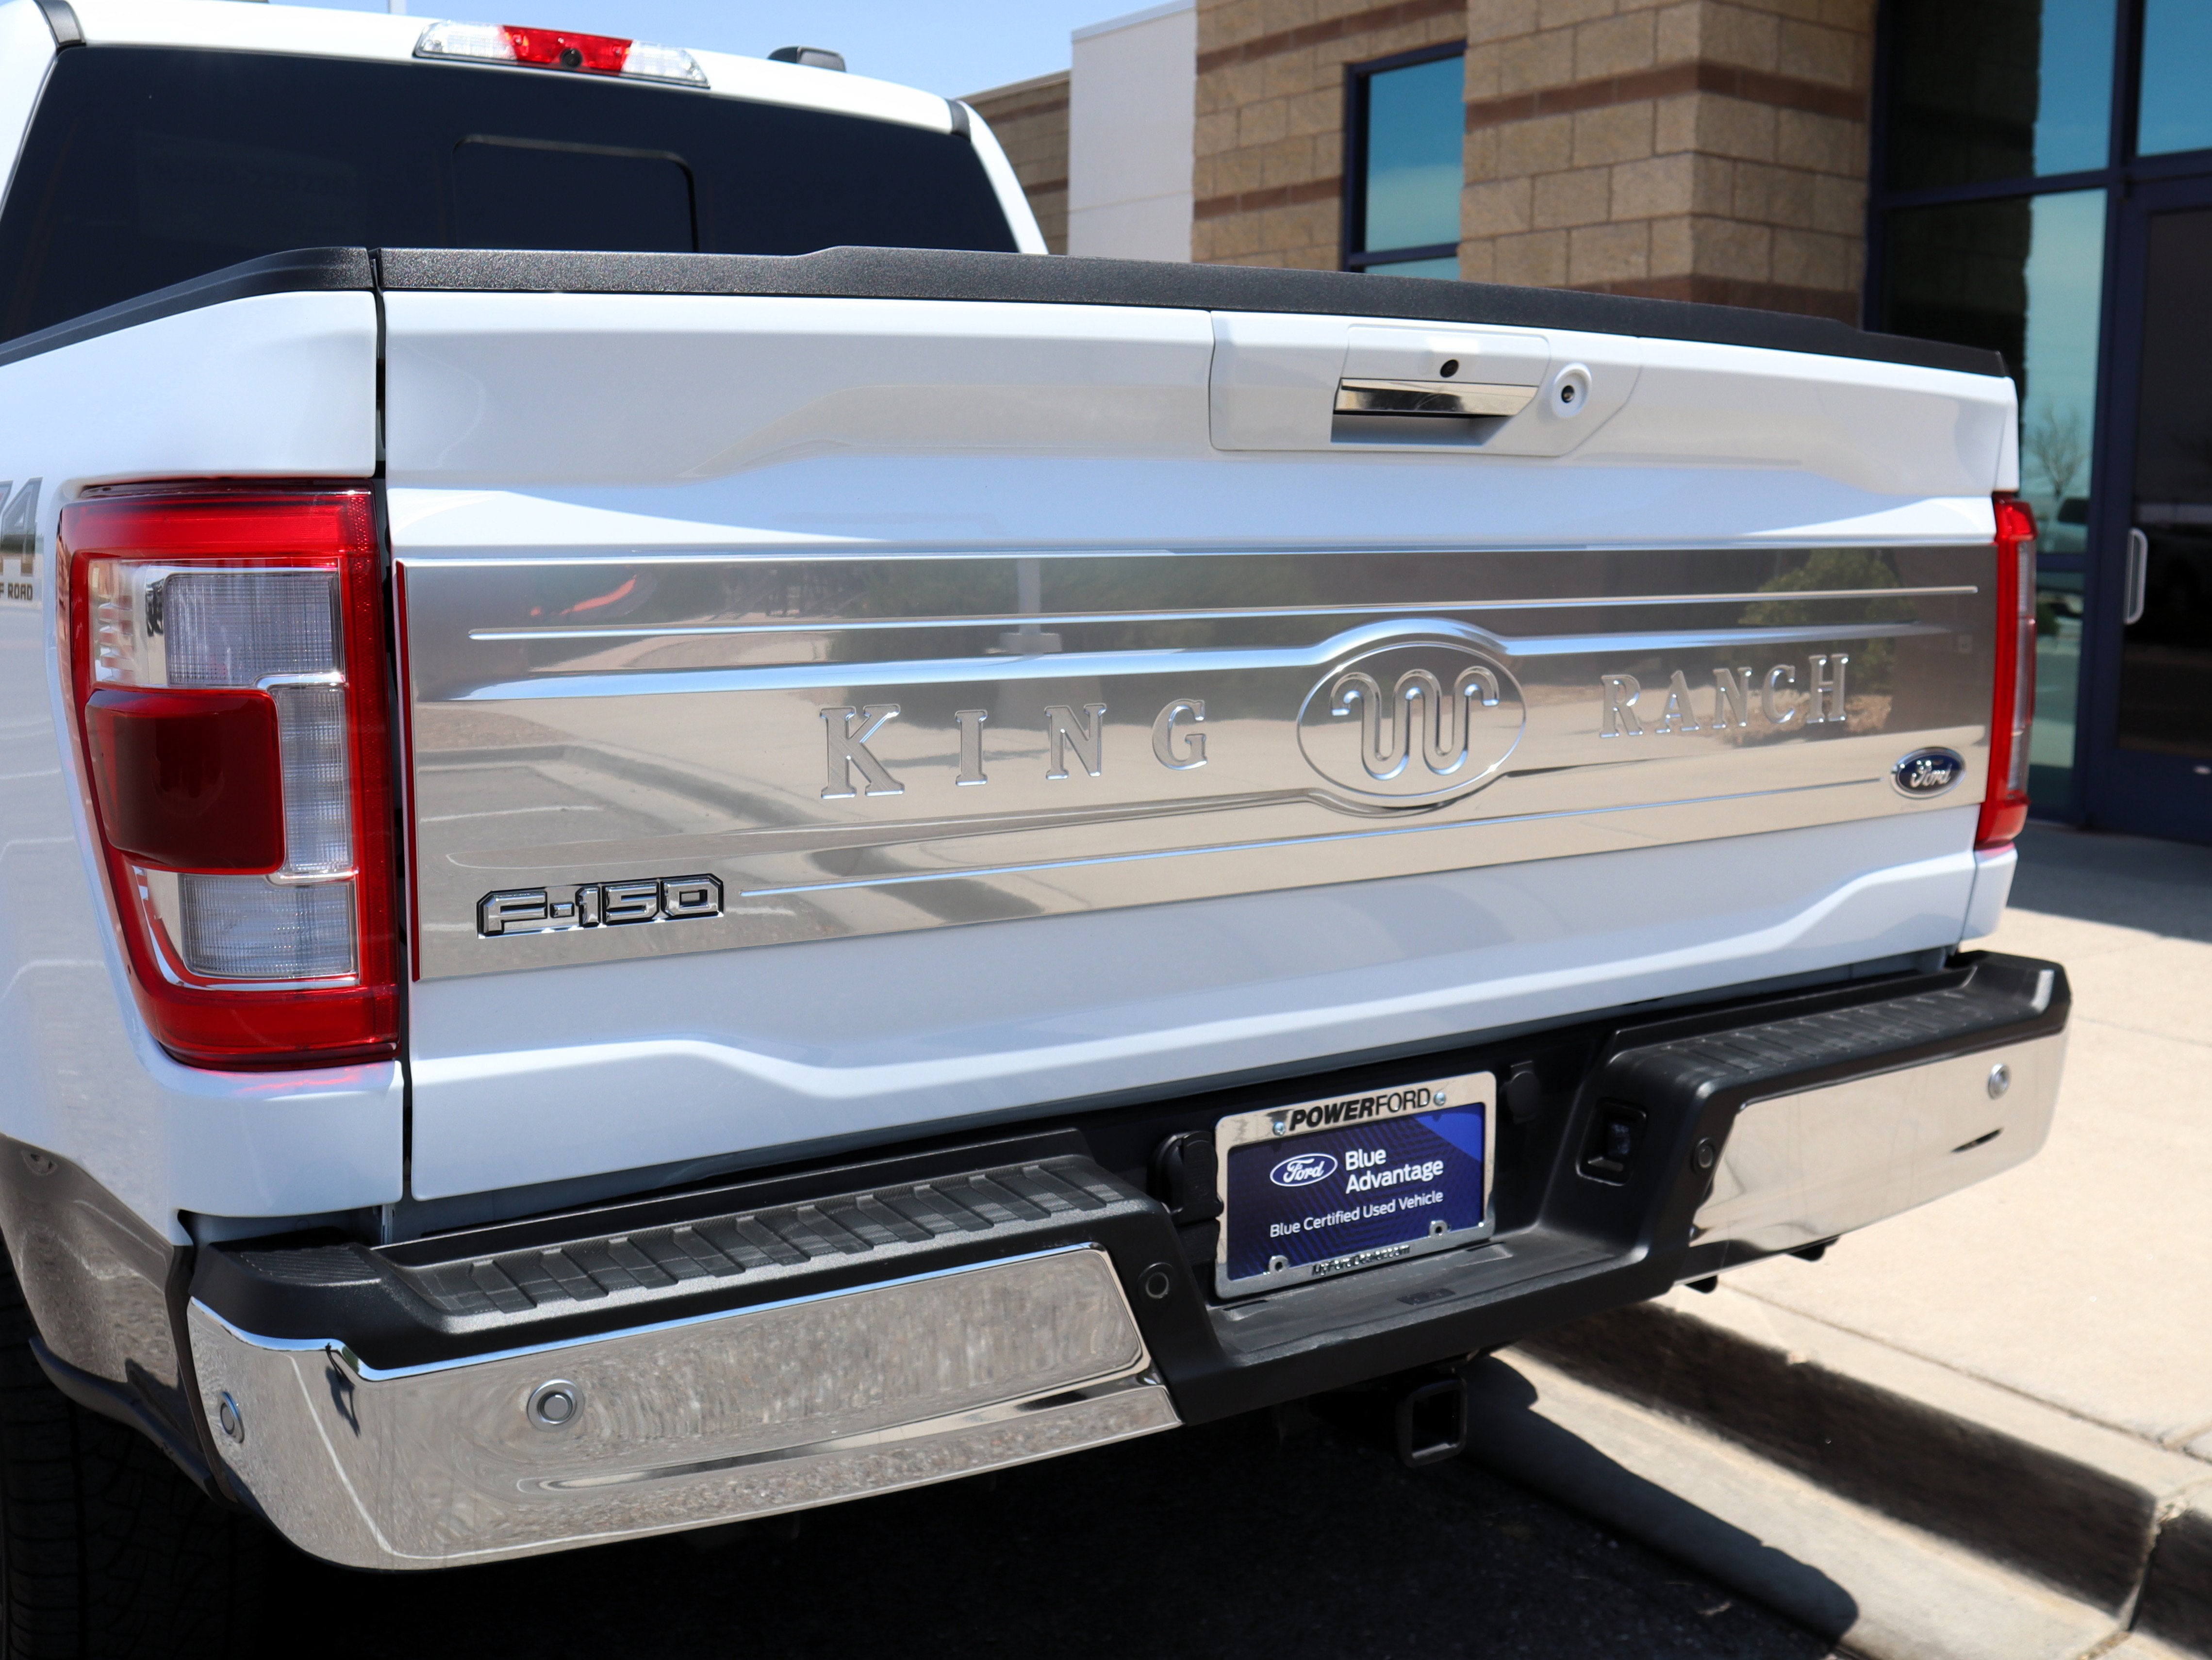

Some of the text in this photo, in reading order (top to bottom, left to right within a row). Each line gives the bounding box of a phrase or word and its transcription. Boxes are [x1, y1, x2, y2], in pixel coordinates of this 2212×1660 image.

[8, 583, 33, 600] ROAD
[1599, 653, 1849, 739] RANCH
[820, 698, 1208, 799] KING
[1910, 760, 1952, 788] Ford
[477, 873, 724, 938] F-150
[1283, 1158, 1325, 1183] Ford
[1345, 1149, 1387, 1170] Blue
[1345, 1159, 1444, 1194] Advantage
[1270, 1191, 1444, 1238] Blue Certified Used Vehicle
